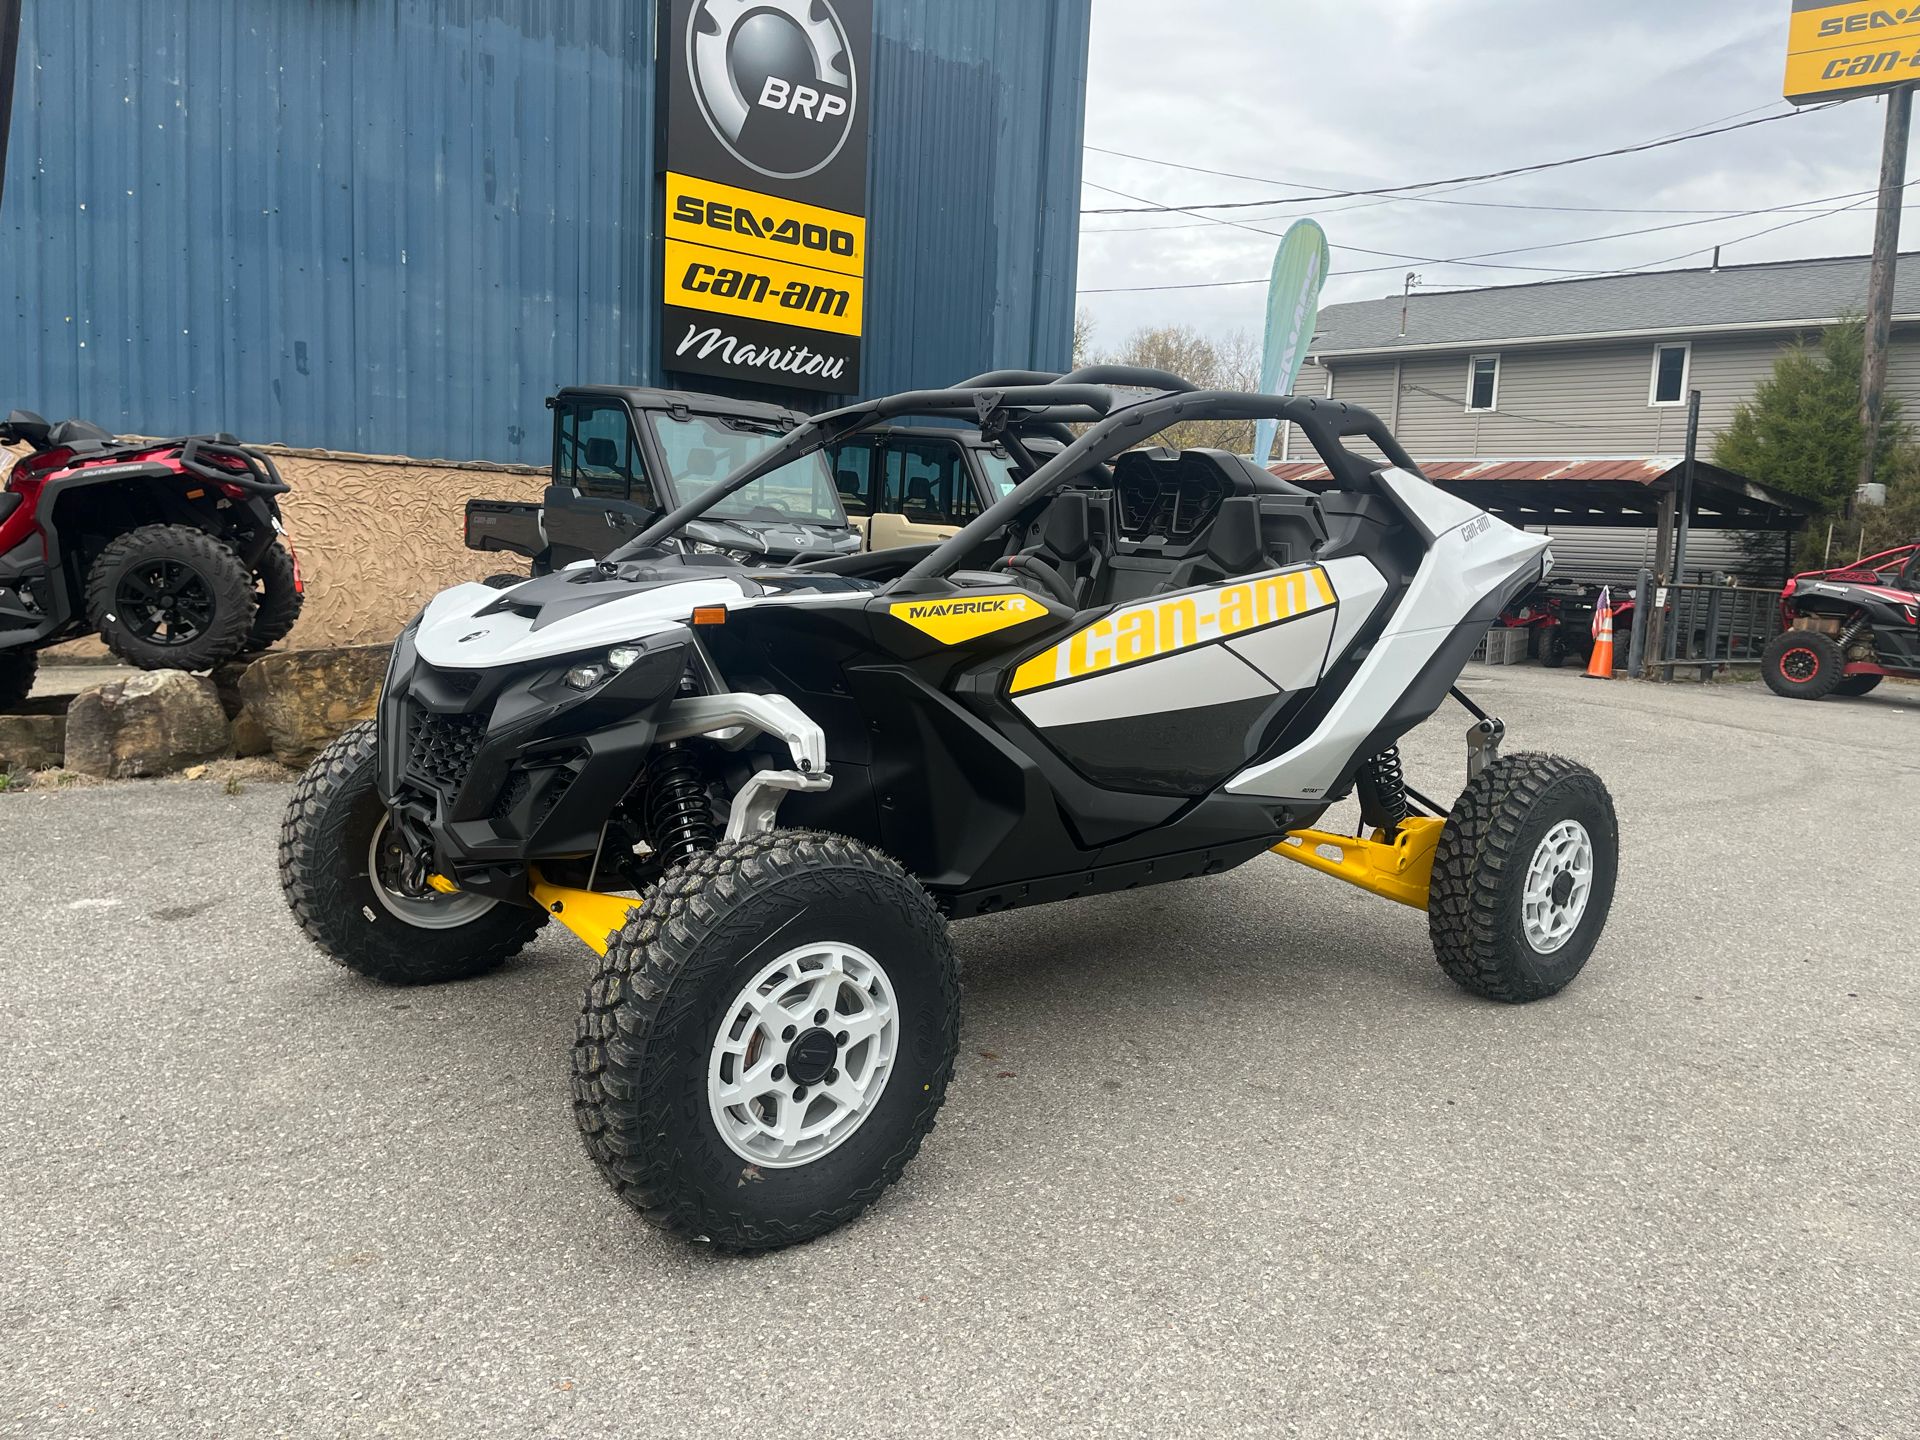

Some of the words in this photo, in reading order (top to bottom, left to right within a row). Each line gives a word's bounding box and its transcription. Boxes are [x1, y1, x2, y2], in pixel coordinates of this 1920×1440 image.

[758, 75, 848, 123] BRP
[681, 262, 850, 318] can-am
[675, 323, 846, 380] Manitou
[1460, 515, 1491, 542] can-am
[909, 600, 1005, 619] MAVERICK
[1007, 598, 1027, 612] R
[1068, 571, 1308, 673] can-am
